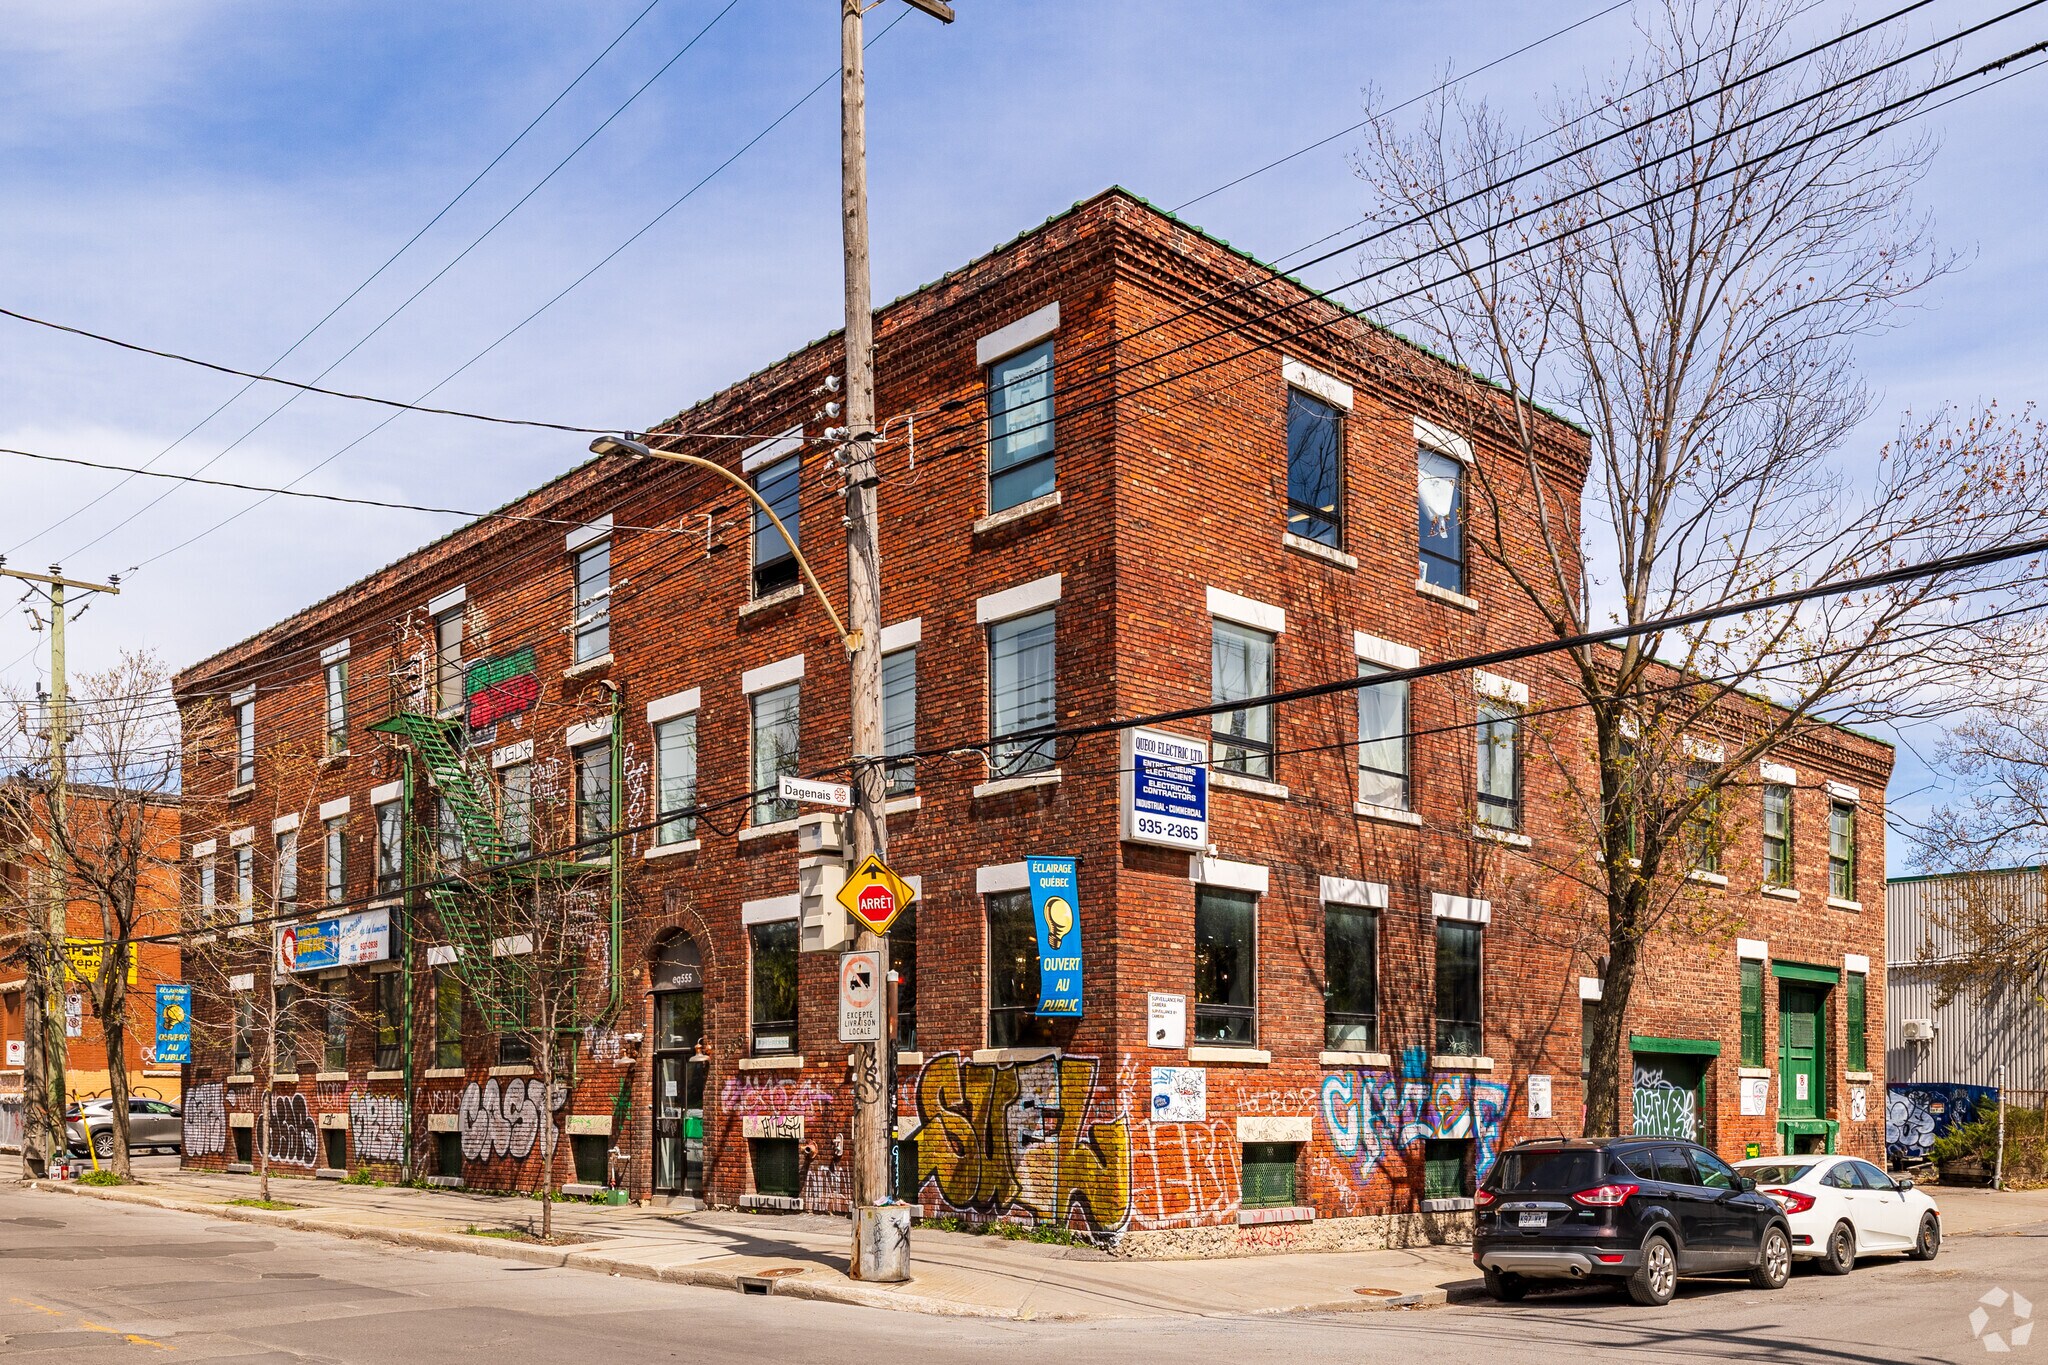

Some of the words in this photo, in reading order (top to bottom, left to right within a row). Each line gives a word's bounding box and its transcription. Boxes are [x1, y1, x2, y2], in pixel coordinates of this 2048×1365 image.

[1135, 737, 1156, 753] QUECO
[1158, 742, 1189, 760] ELECTRIC
[1190, 748, 1203, 763] LTD
[1143, 759, 1197, 776] ENTREPRENEURS
[784, 784, 831, 801] Dagenais
[1142, 786, 1197, 802] CONTRACTORS
[1148, 780, 1192, 794] ELECTRICAL
[1136, 798, 1166, 812] INDUSTRIAL
[1168, 804, 1203, 818] COMMERCIAL
[1032, 861, 1072, 874] ÉCLAIRAGE
[1039, 876, 1070, 888] QUÉBEC
[860, 894, 892, 910] ARRÊT
[1043, 957, 1081, 972] OUVERT
[672, 973, 693, 986] eq555
[1055, 978, 1071, 992] AU
[1041, 998, 1079, 1013] PUBLIC
[844, 1019, 876, 1028] LIVRAISON
[158, 1033, 189, 1042] OUVERT
[848, 1027, 871, 1036] LOCALE
[167, 1043, 180, 1052] AU
[159, 1053, 188, 1061] PUBLIC
